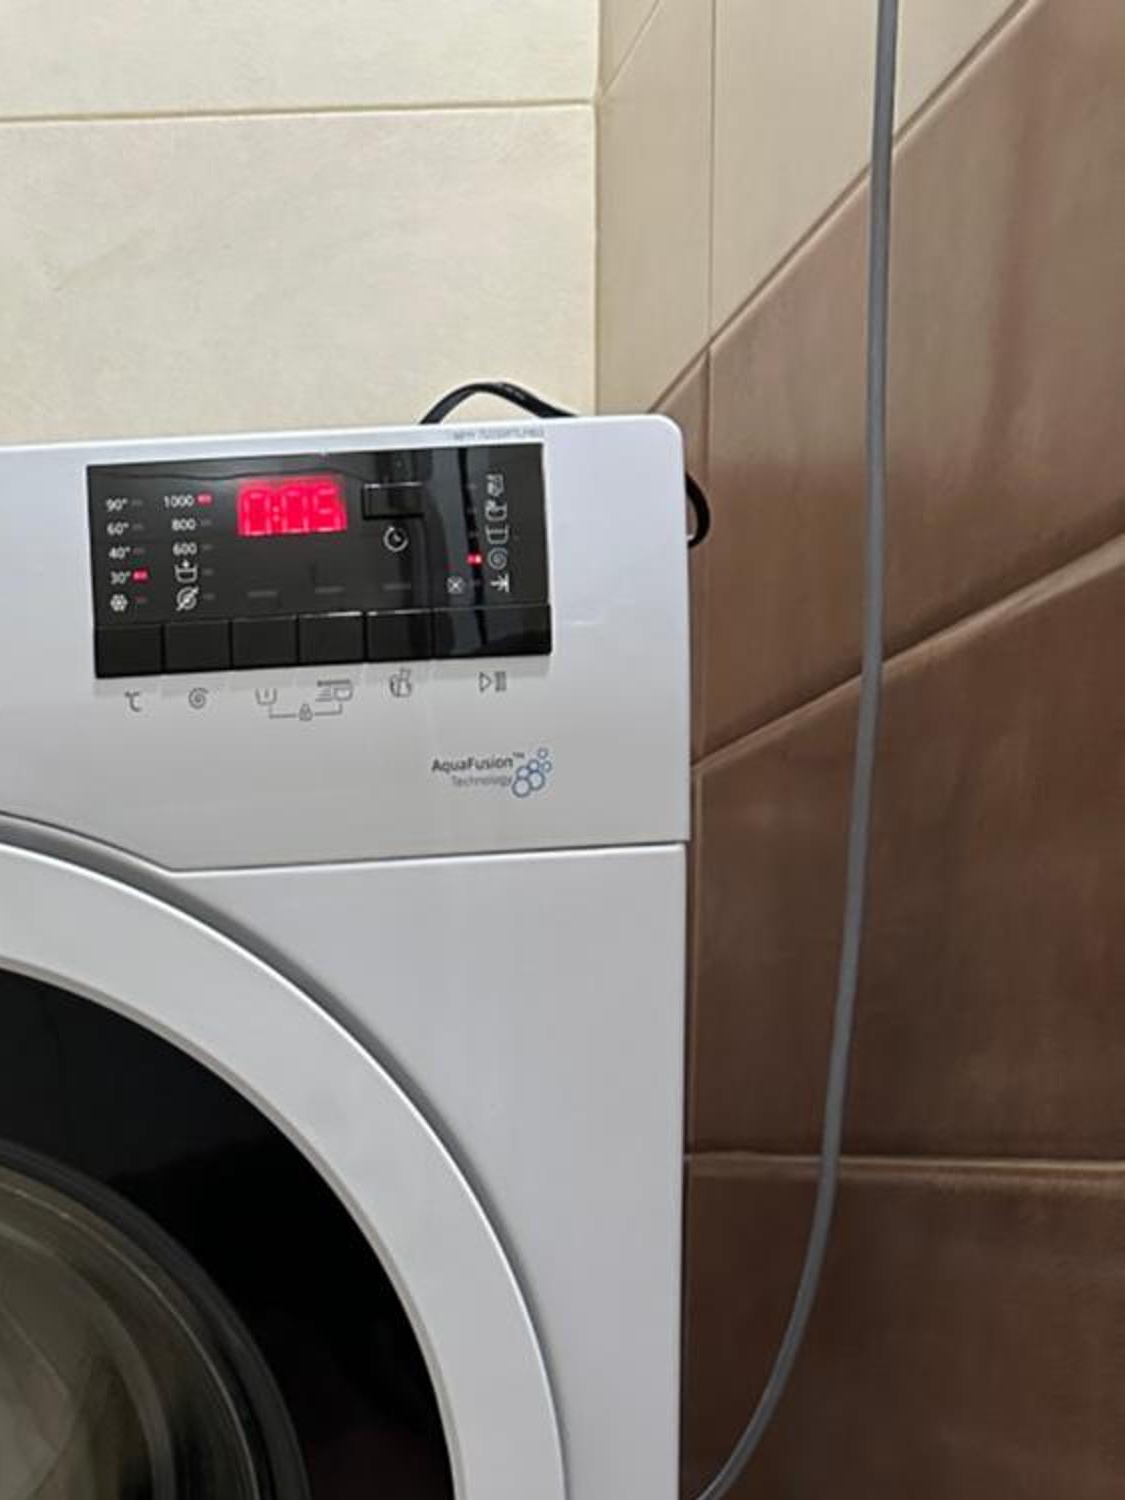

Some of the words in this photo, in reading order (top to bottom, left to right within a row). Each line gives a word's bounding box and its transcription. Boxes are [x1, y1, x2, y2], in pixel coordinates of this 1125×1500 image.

[164, 494, 194, 508] 1000
[171, 519, 196, 531] 800
[173, 542, 197, 556] 600
